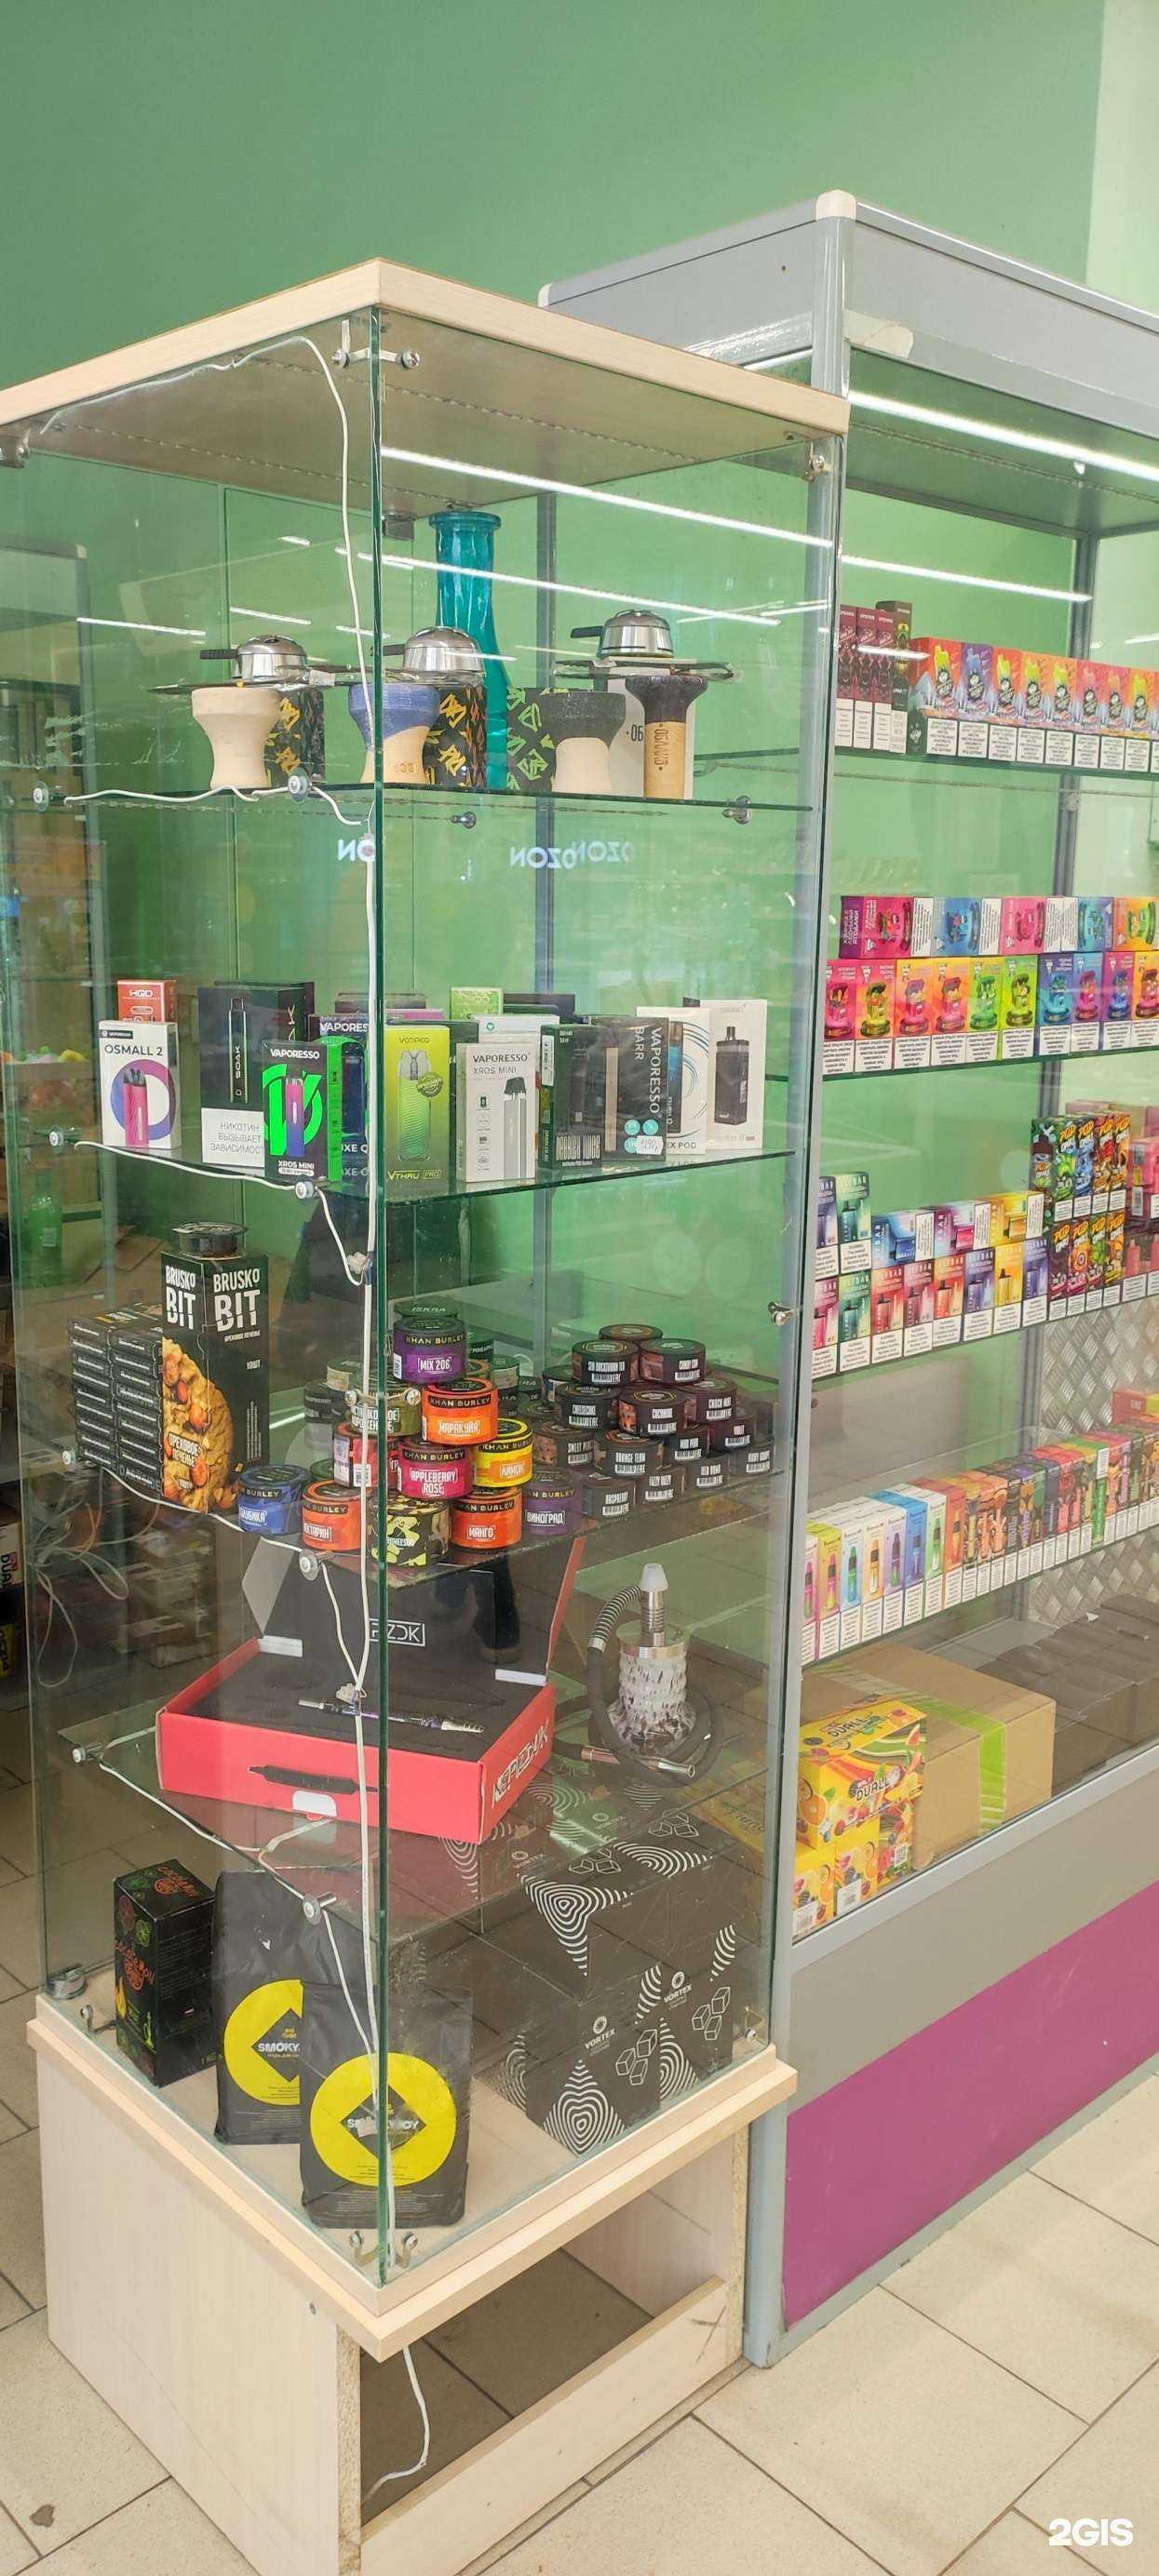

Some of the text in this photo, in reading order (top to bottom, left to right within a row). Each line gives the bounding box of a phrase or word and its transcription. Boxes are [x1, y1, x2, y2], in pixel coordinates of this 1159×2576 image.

[129, 989, 154, 999] HQD
[104, 1043, 164, 1056] OSMALL 2
[633, 1026, 645, 1061] BARR
[269, 1048, 320, 1060] VAPORESSO
[472, 1053, 528, 1065] VAPORESSO
[234, 1045, 242, 1080] SOAK
[473, 1065, 517, 1076] XROS MINI
[650, 1026, 663, 1114] VAPORESSO
[220, 1121, 260, 1132] НИКОТИН
[218, 1132, 262, 1144] ВЫЗЫВАЕТ
[678, 1140, 697, 1149] POD
[298, 1161, 315, 1171] MINI
[165, 1265, 196, 1291] BRUSKO
[212, 1268, 261, 1294] BRUSKO
[166, 1286, 196, 1330] BIT
[214, 1289, 261, 1333] BIT
[405, 1333, 465, 1345] KHAN BURLEY
[420, 1359, 434, 1371] MIX
[429, 1396, 492, 1408] KHAN BURLEY
[168, 1433, 199, 1457] ОРЕХОВОЕ
[430, 1449, 465, 1462] BURLEY
[410, 1469, 457, 1483] APPLEBERRY
[246, 1487, 279, 1497] BURLEY
[422, 1482, 444, 1495] ROSE
[541, 1488, 575, 1499] BURLEY
[312, 1504, 347, 1513] BURLEY
[479, 1500, 514, 1512] BURLEY
[526, 1510, 565, 1524] ВИНОГРАД
[468, 1525, 494, 1538] МАНГО
[856, 1776, 892, 1802] DUALL
[663, 1983, 693, 2004] VORTEX
[584, 2027, 615, 2049] VORTEX
